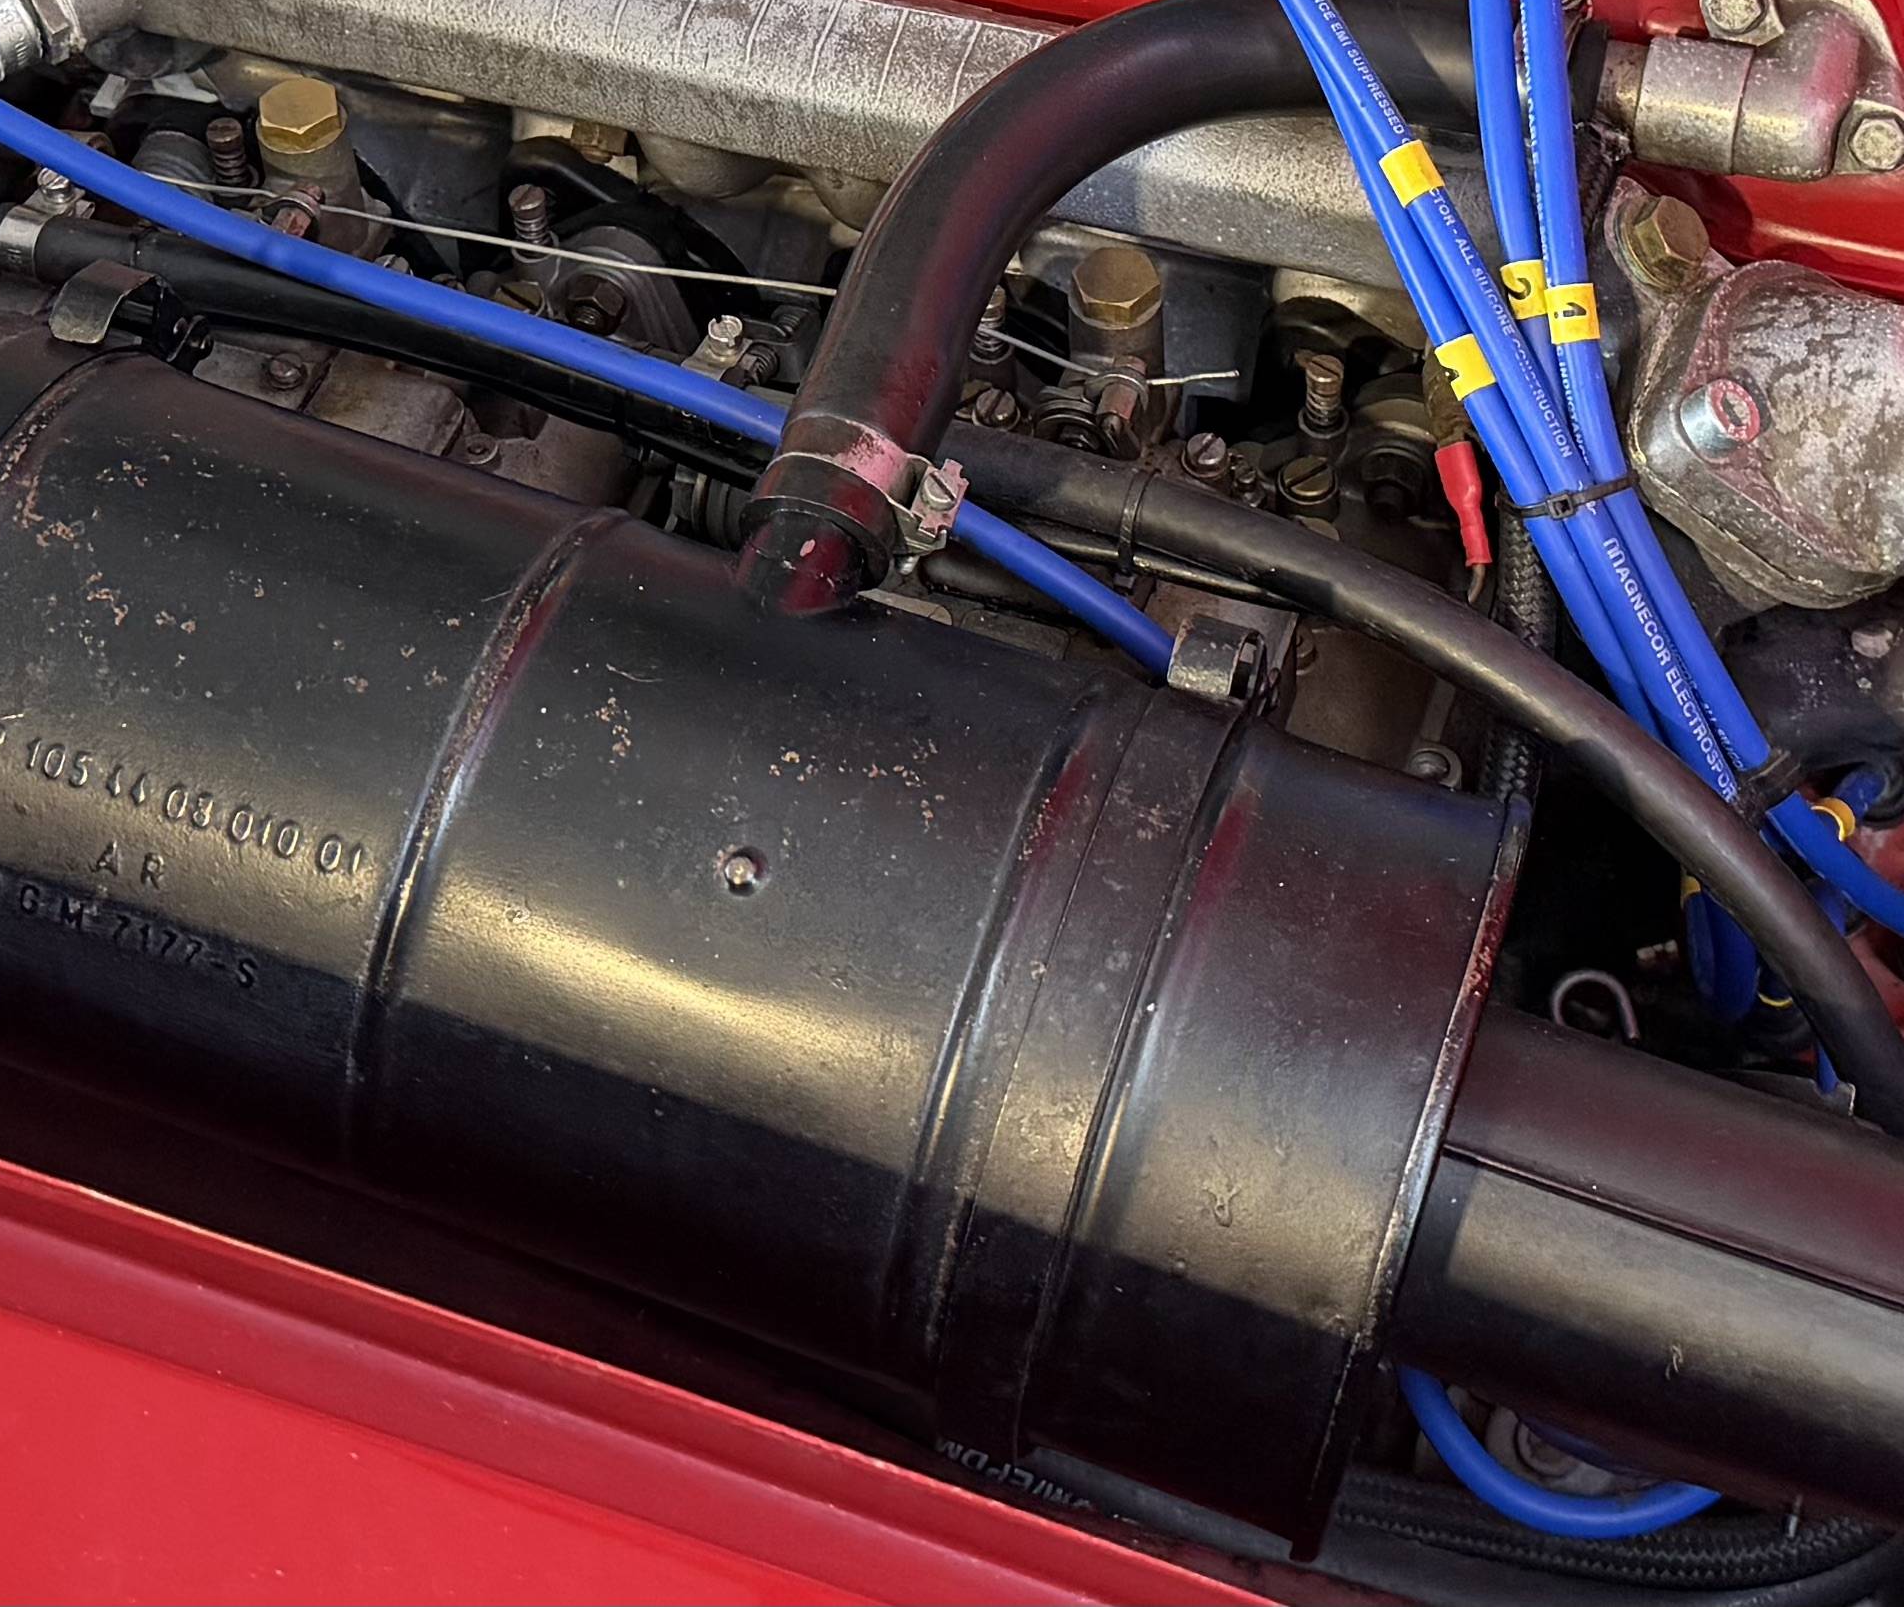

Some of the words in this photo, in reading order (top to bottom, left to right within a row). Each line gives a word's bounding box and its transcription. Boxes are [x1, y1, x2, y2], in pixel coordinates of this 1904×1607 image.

[1330, 21, 1352, 48] EMI
[1347, 47, 1407, 137] SUPPRESSED
[1454, 237, 1475, 267] ALL
[1471, 266, 1516, 337] SILICONE
[1601, 536, 1674, 666] MAGNECOR
[23, 735, 95, 788] 105
[229, 805, 300, 859] 010
[317, 830, 366, 876] 01
